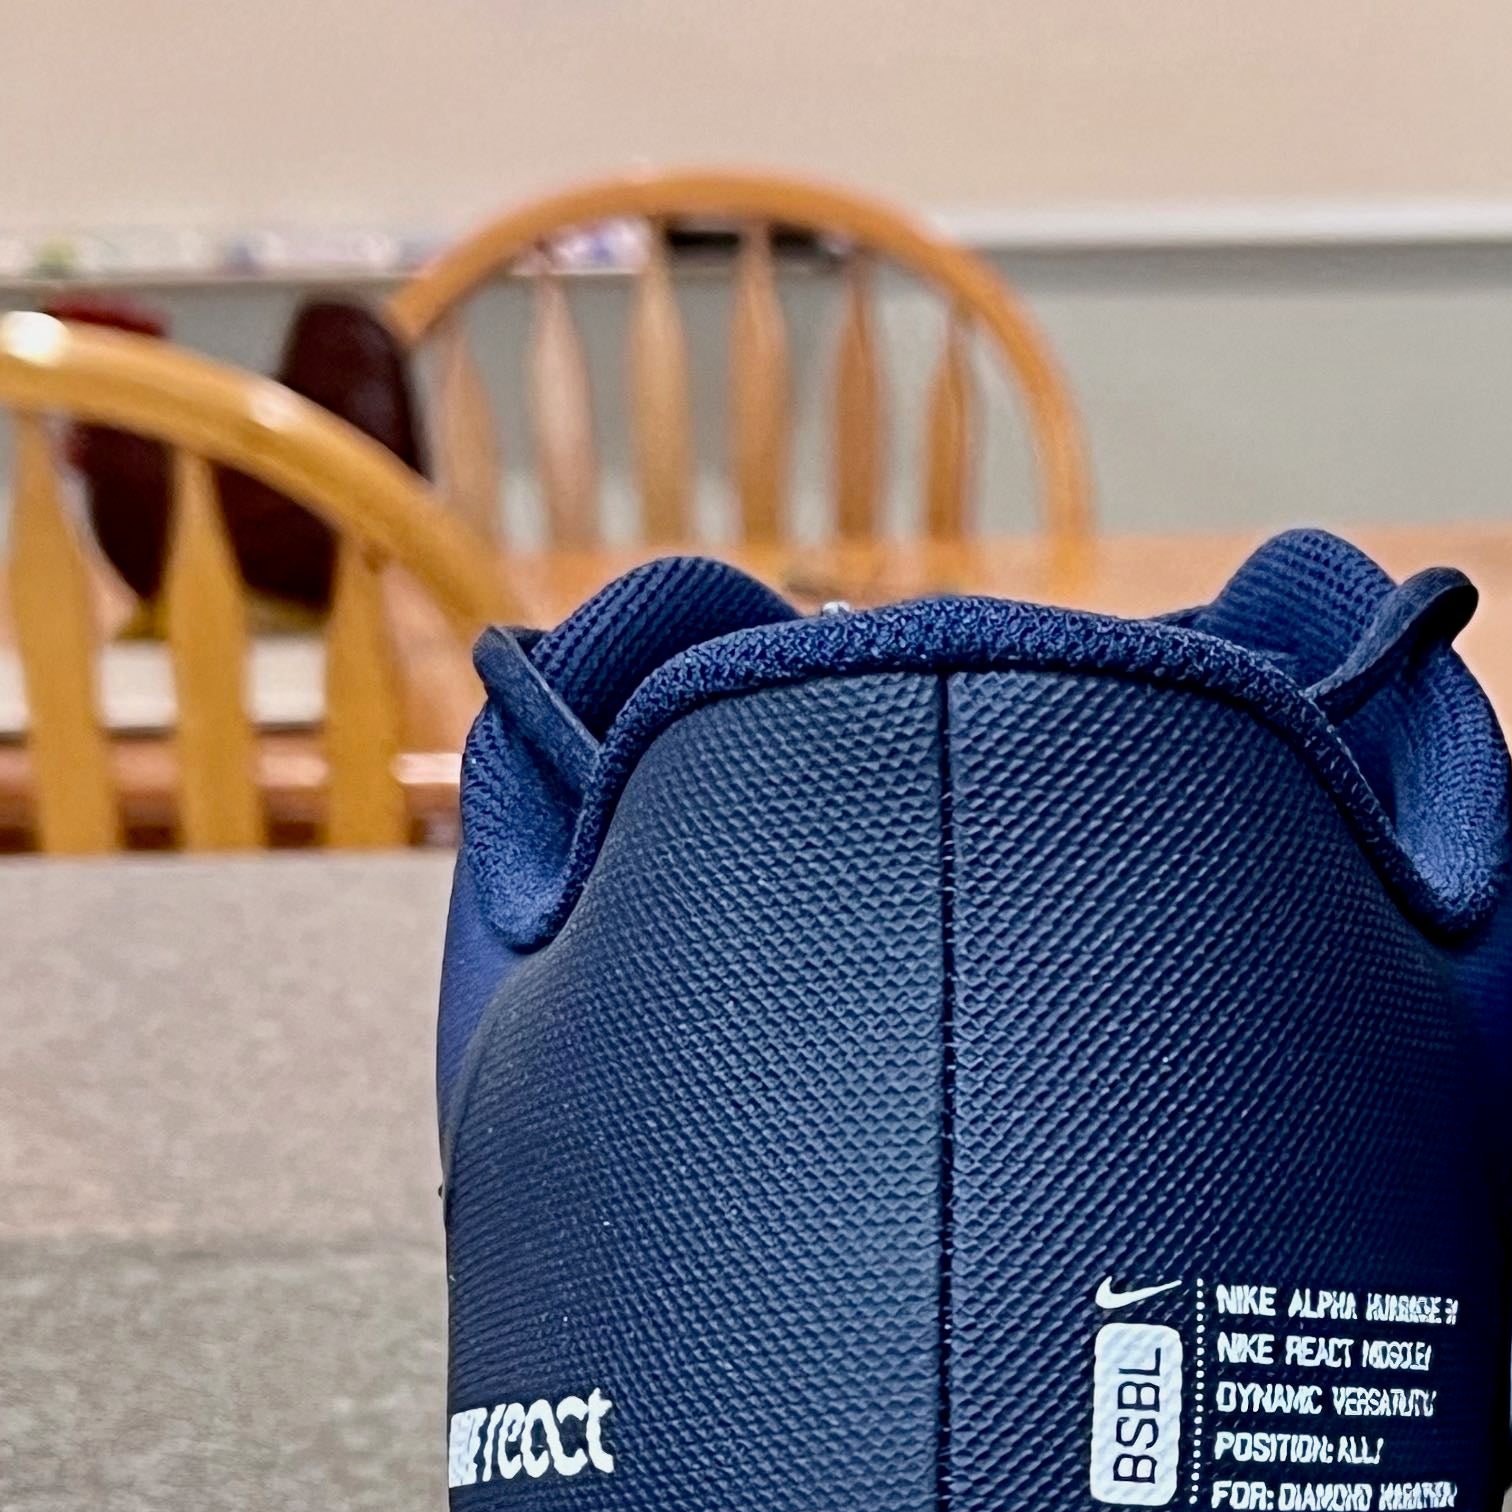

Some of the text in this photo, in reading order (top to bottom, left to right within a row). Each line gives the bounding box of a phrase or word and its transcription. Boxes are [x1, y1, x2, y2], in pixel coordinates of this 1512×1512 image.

[1215, 1284, 1277, 1317] NIKE
[1287, 1288, 1358, 1320] ALPHA
[1217, 1331, 1275, 1365] NIKE
[1285, 1335, 1355, 1368] REACT
[1215, 1381, 1323, 1415] DYNAMIC
[1112, 1347, 1162, 1485] BSBL
[1214, 1431, 1384, 1465] POSITION: ALL/
[1211, 1480, 1275, 1511] FOR:
[1278, 1482, 1373, 1512] DIAMOND
